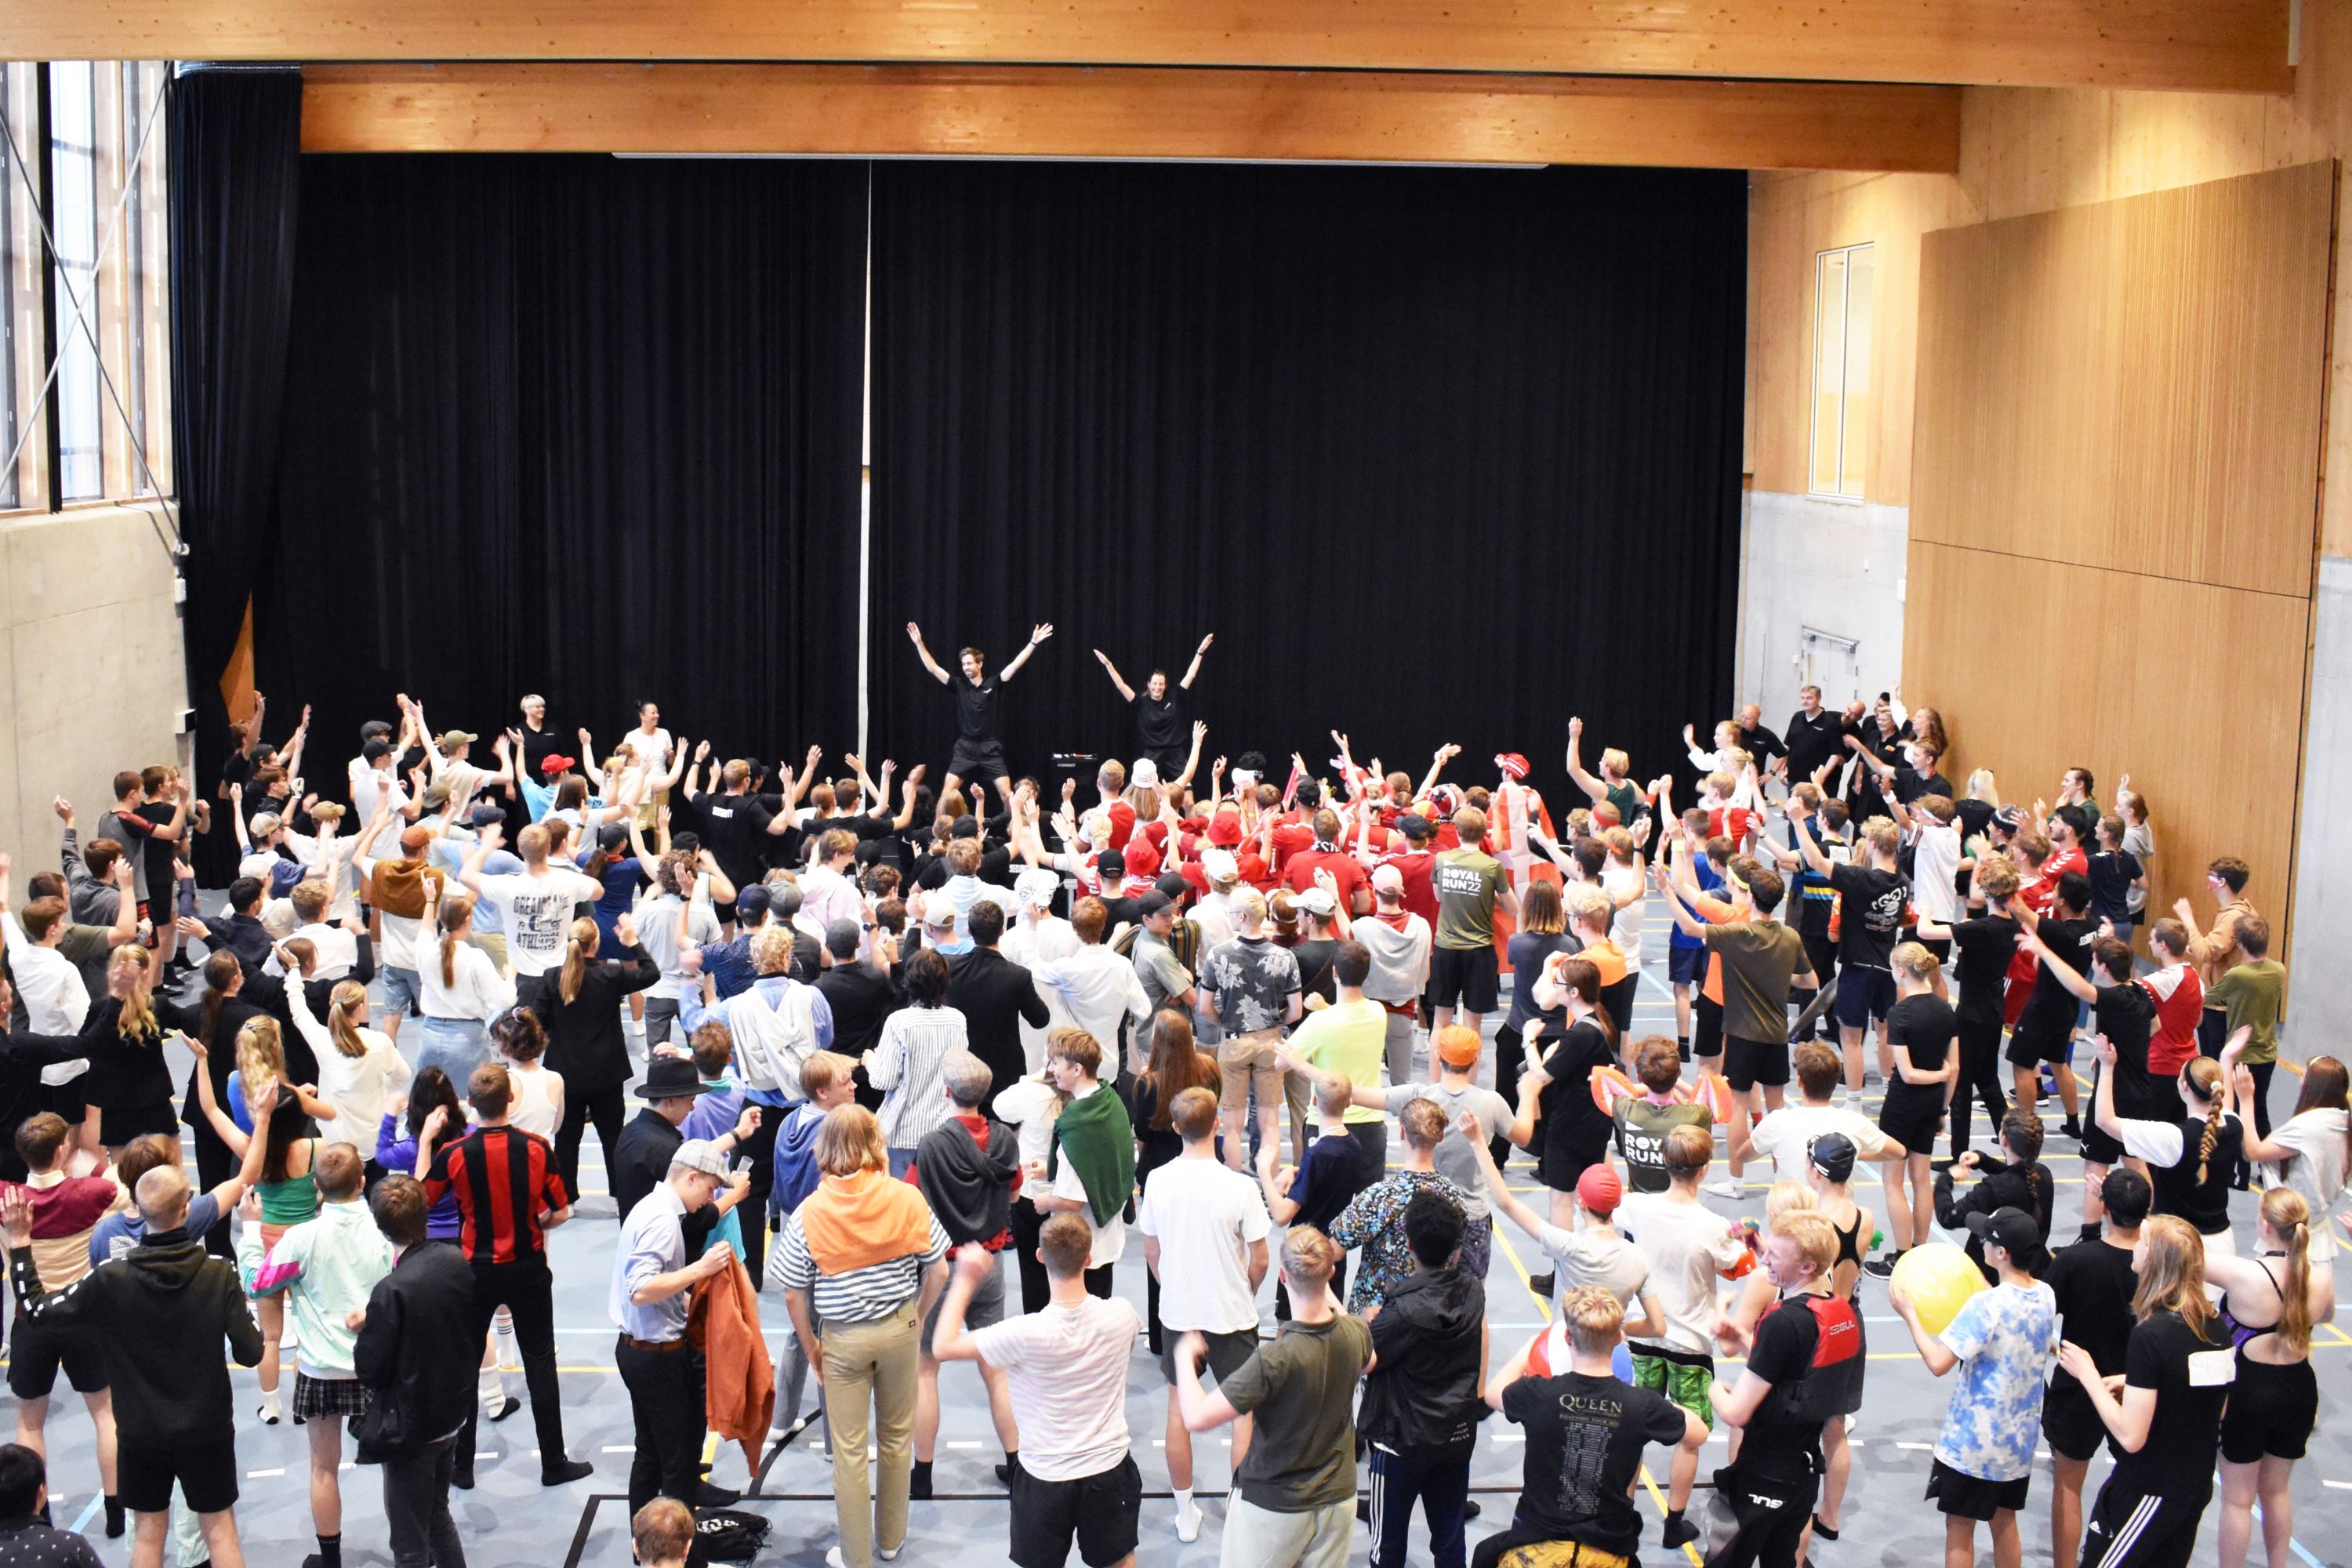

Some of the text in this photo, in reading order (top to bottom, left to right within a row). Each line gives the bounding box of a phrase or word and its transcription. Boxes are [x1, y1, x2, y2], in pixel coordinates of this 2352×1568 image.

[1443, 868, 1482, 882] ROYAL
[1625, 1132, 1662, 1151] ROY
[1625, 1145, 1664, 1164] RUN
[1559, 1394, 1623, 1414] QUEEN
